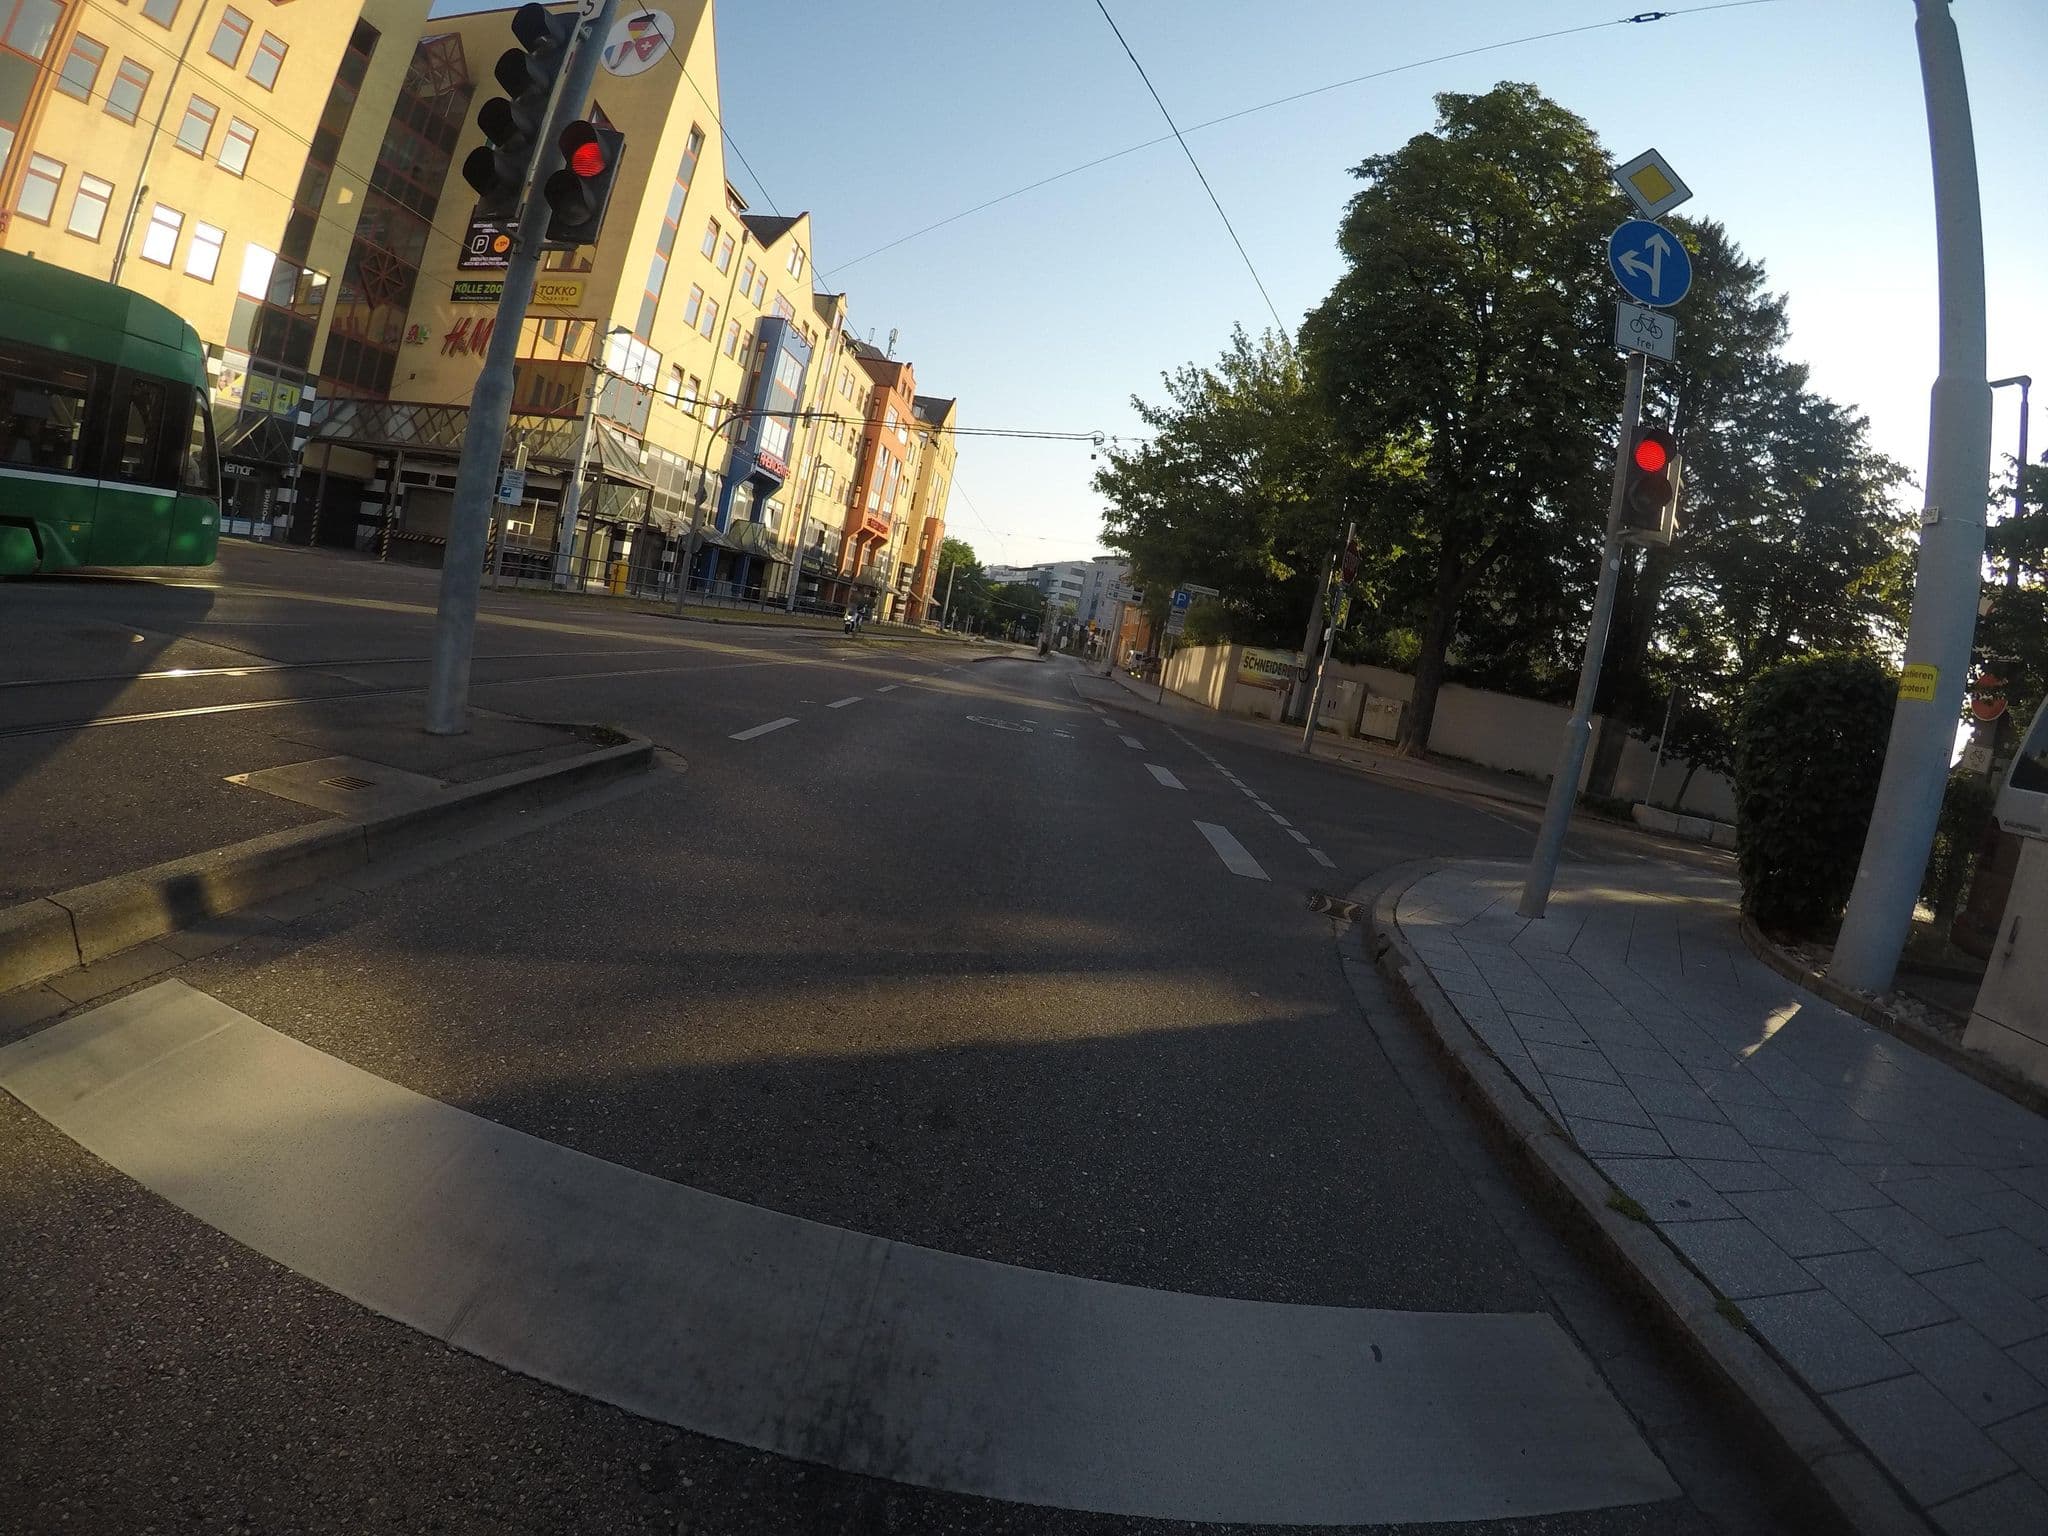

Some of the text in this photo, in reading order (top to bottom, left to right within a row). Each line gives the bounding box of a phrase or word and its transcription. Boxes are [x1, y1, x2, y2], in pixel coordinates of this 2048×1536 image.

[455, 282, 503, 294] KÖLLE ZOO
[440, 317, 497, 358] H&M
[1637, 337, 1655, 350] frei
[1177, 592, 1188, 605] P
